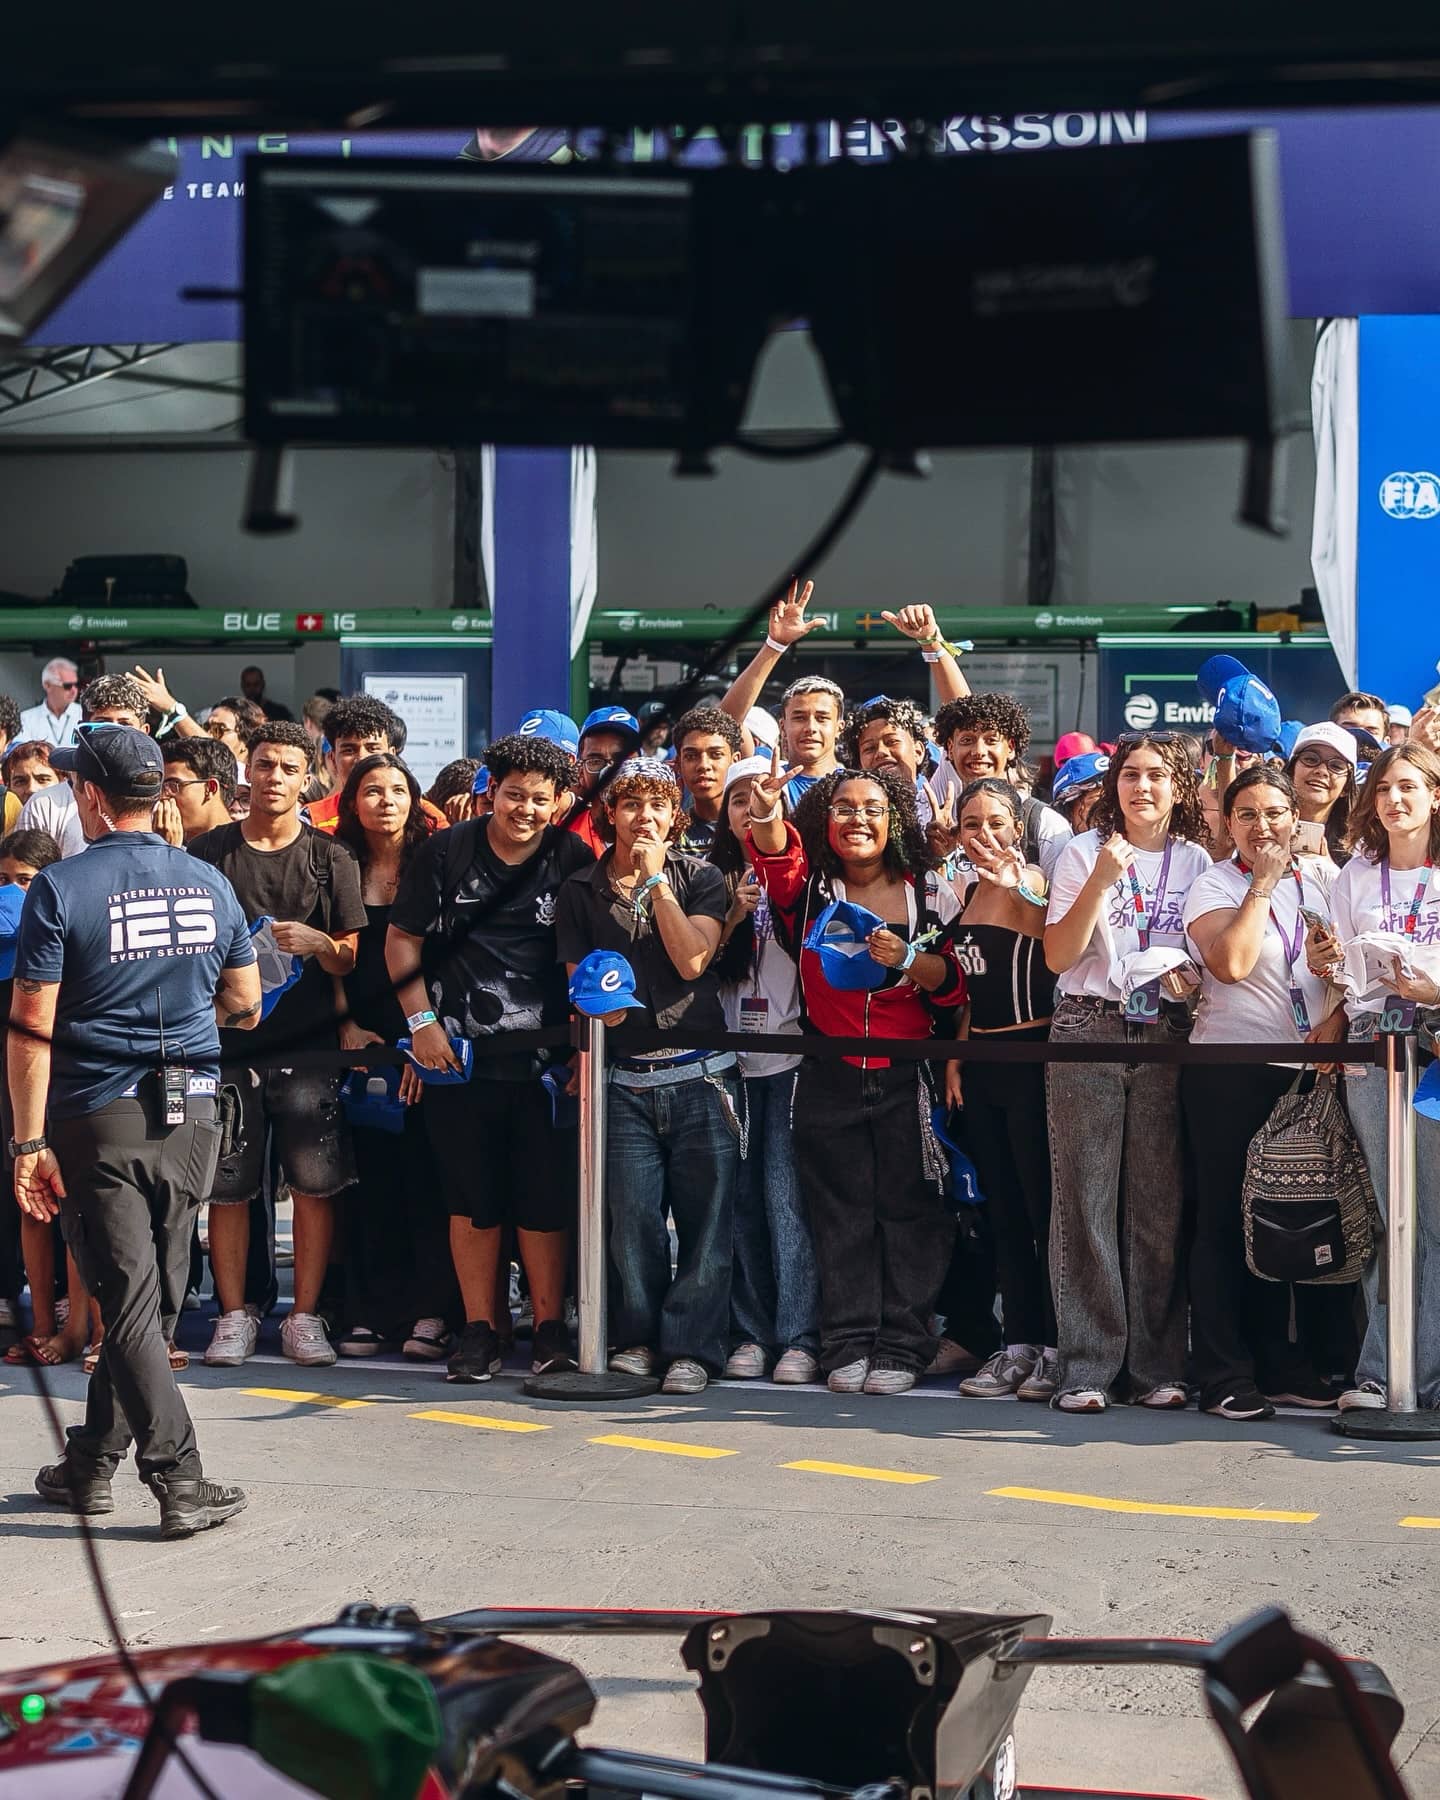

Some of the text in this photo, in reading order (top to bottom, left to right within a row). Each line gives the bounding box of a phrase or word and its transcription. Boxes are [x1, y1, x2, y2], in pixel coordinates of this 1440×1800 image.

[829, 110, 1147, 158] ERKSSON
[186, 182, 246, 199] TEAM
[87, 617, 128, 629] Envision
[223, 613, 356, 631] BUE 16
[639, 618, 684, 629] Envision
[1055, 615, 1104, 626] Envision
[108, 887, 211, 904] INTERNATIONAL
[110, 944, 215, 964] EVENT SECURITY
